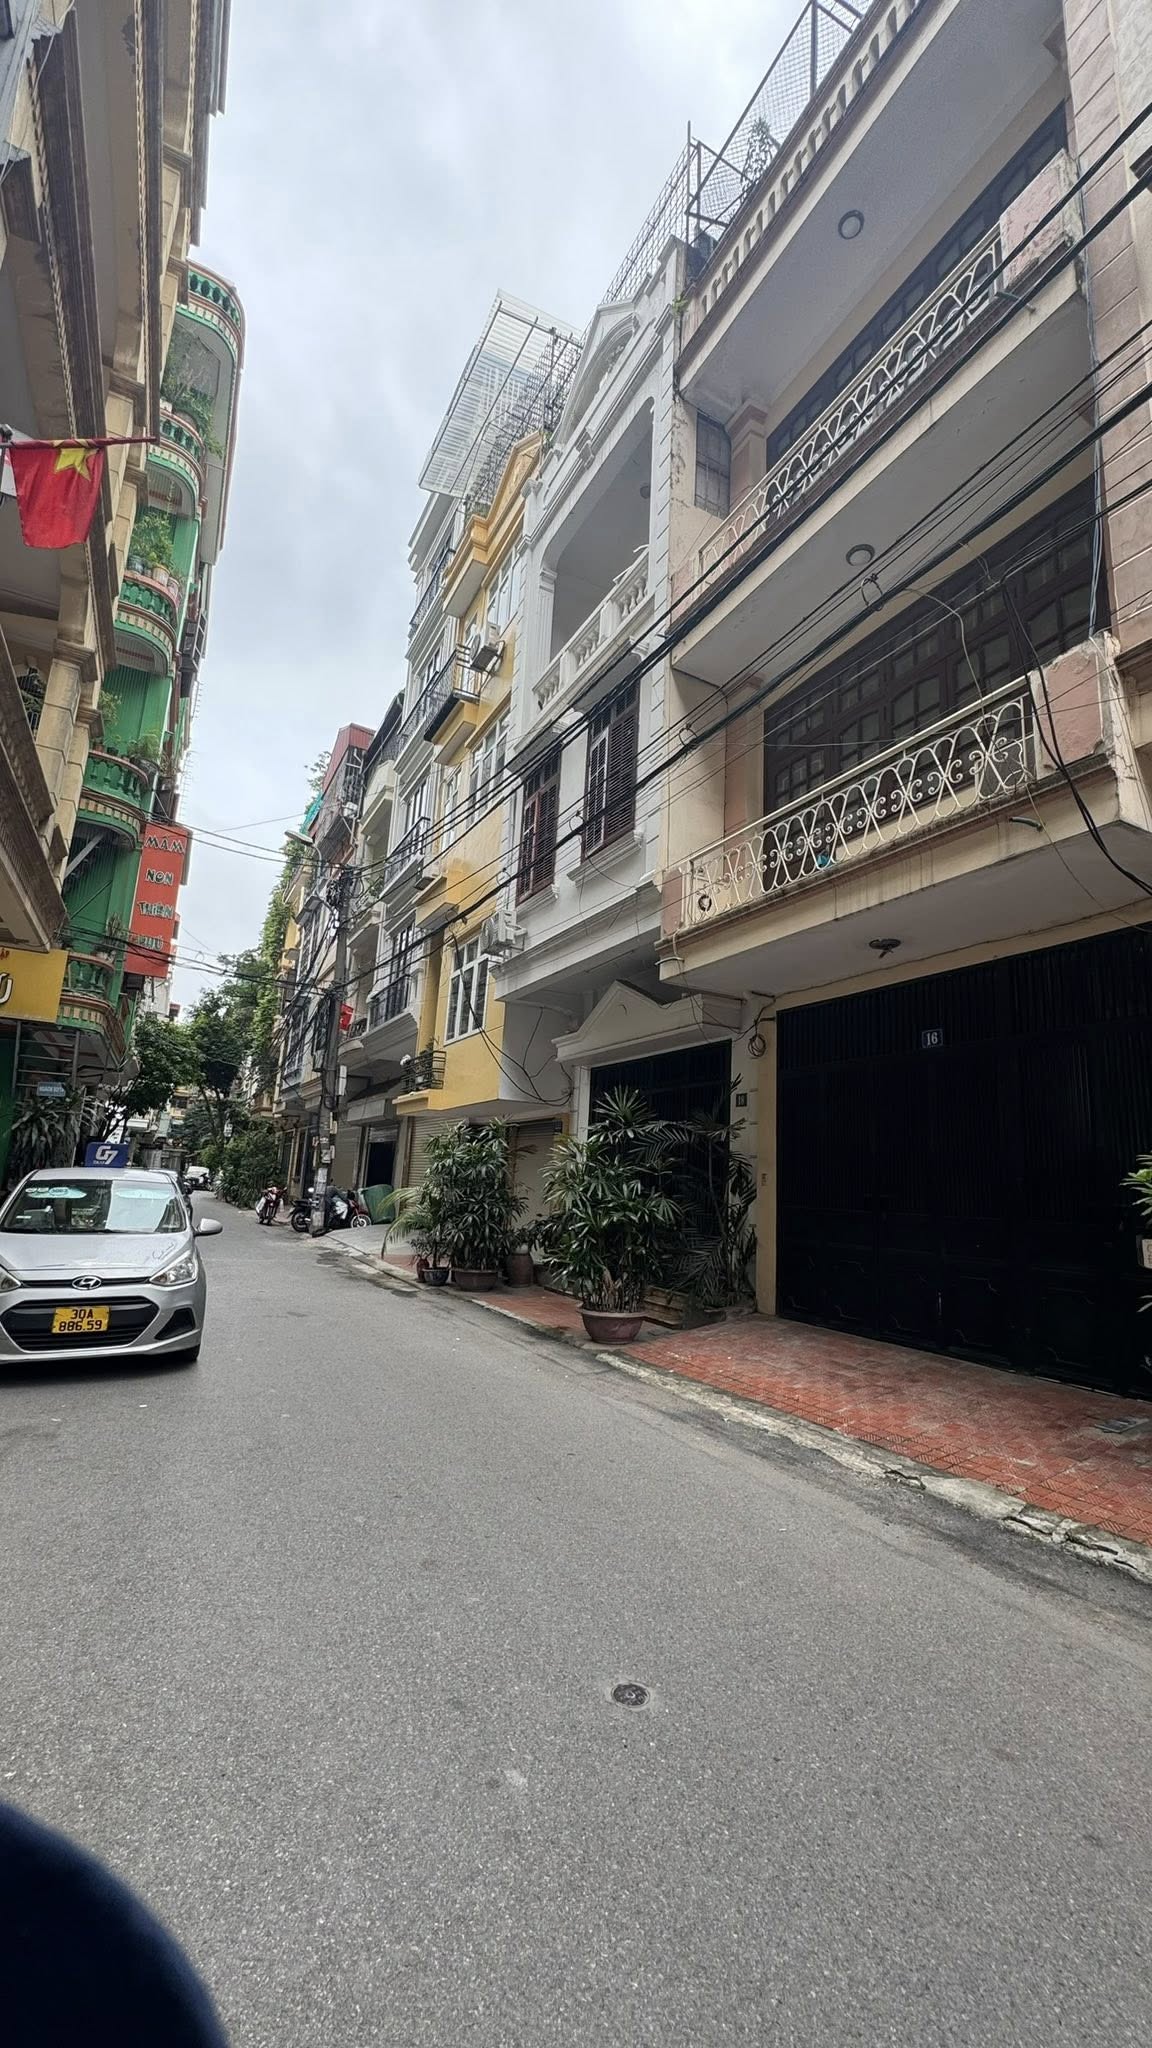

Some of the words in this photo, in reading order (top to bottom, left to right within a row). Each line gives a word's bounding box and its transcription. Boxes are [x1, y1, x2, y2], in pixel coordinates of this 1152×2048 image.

[145, 868, 174, 885] NON
[927, 1031, 938, 1046] 16
[95, 1145, 119, 1165] G7
[70, 1308, 94, 1320] 30A
[58, 1319, 103, 1332] 886.59
